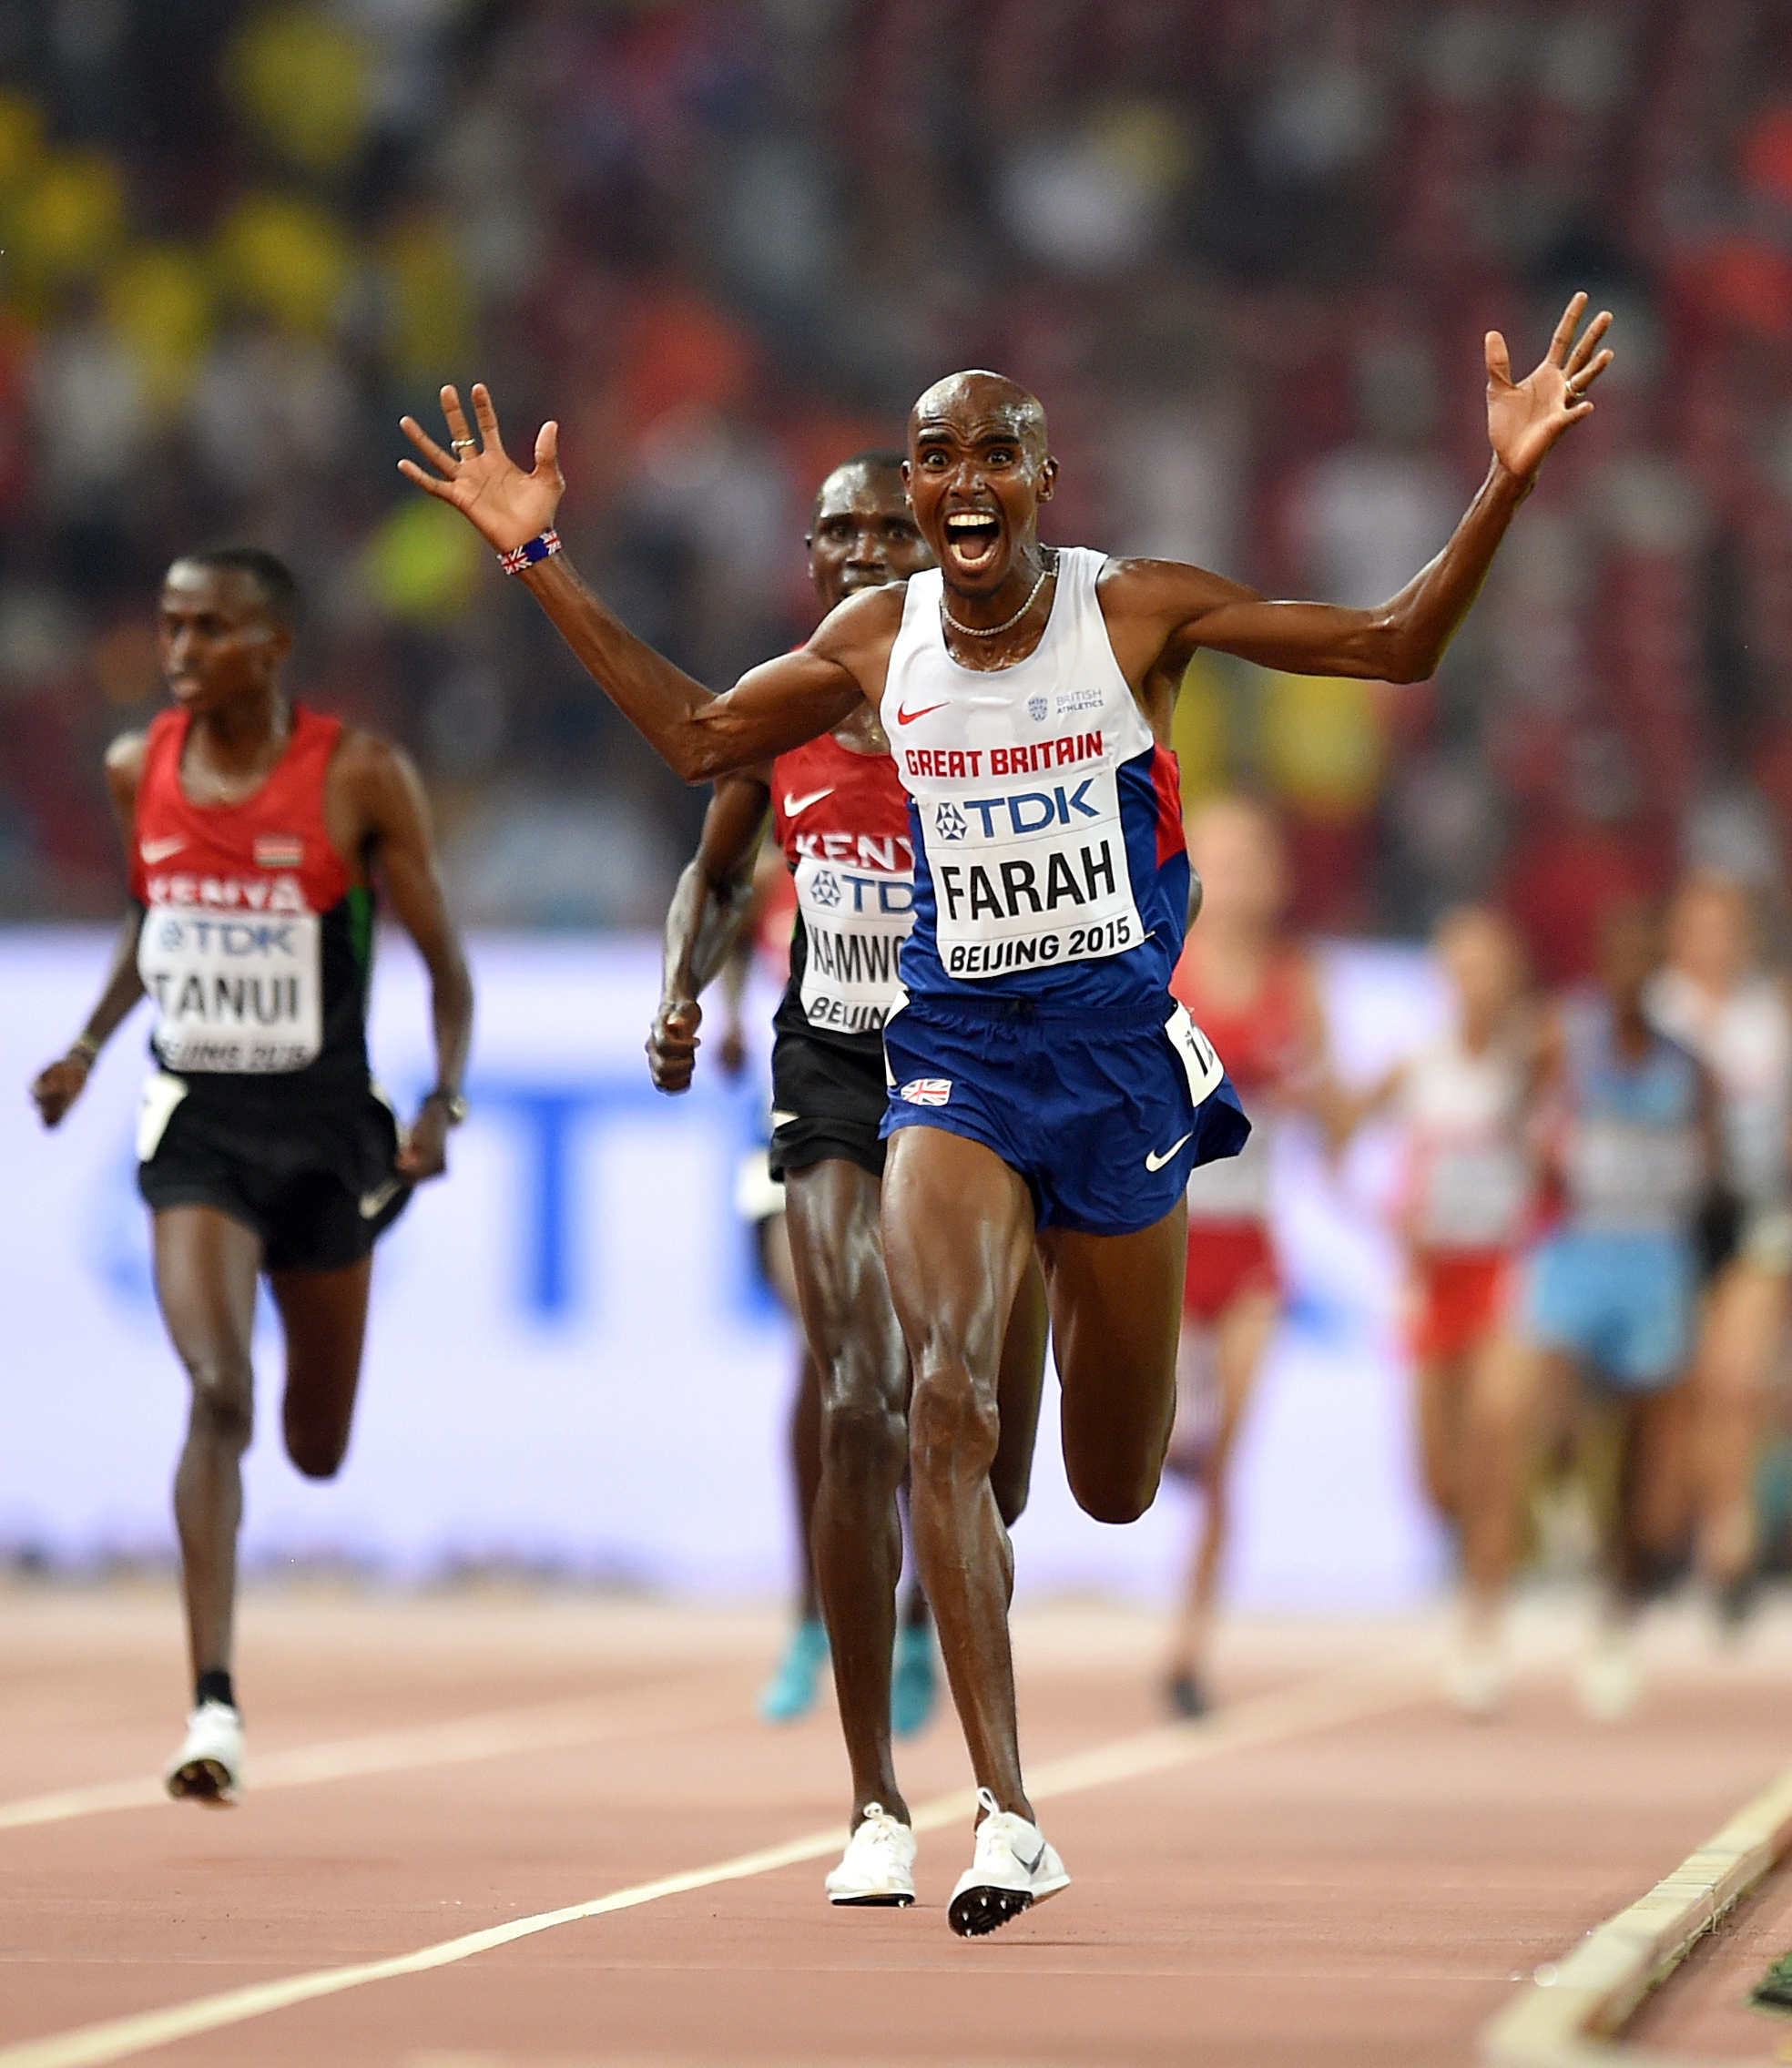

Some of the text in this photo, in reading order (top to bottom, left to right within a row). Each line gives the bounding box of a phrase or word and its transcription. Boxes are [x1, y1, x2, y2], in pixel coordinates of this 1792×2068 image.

[1056, 689, 1102, 706] BRITISH
[1057, 699, 1104, 714] ATHLETICS
[905, 731, 1104, 778] GREAT BRITAIN
[964, 779, 1100, 838] TDK
[796, 833, 915, 871] KENY
[840, 874, 914, 914] TD
[941, 840, 1116, 921] FARAH
[191, 922, 297, 954] TDK
[950, 916, 1131, 973] BEIJING 2015
[154, 971, 300, 1024] TANUI
[807, 996, 891, 1030] BEIJIN
